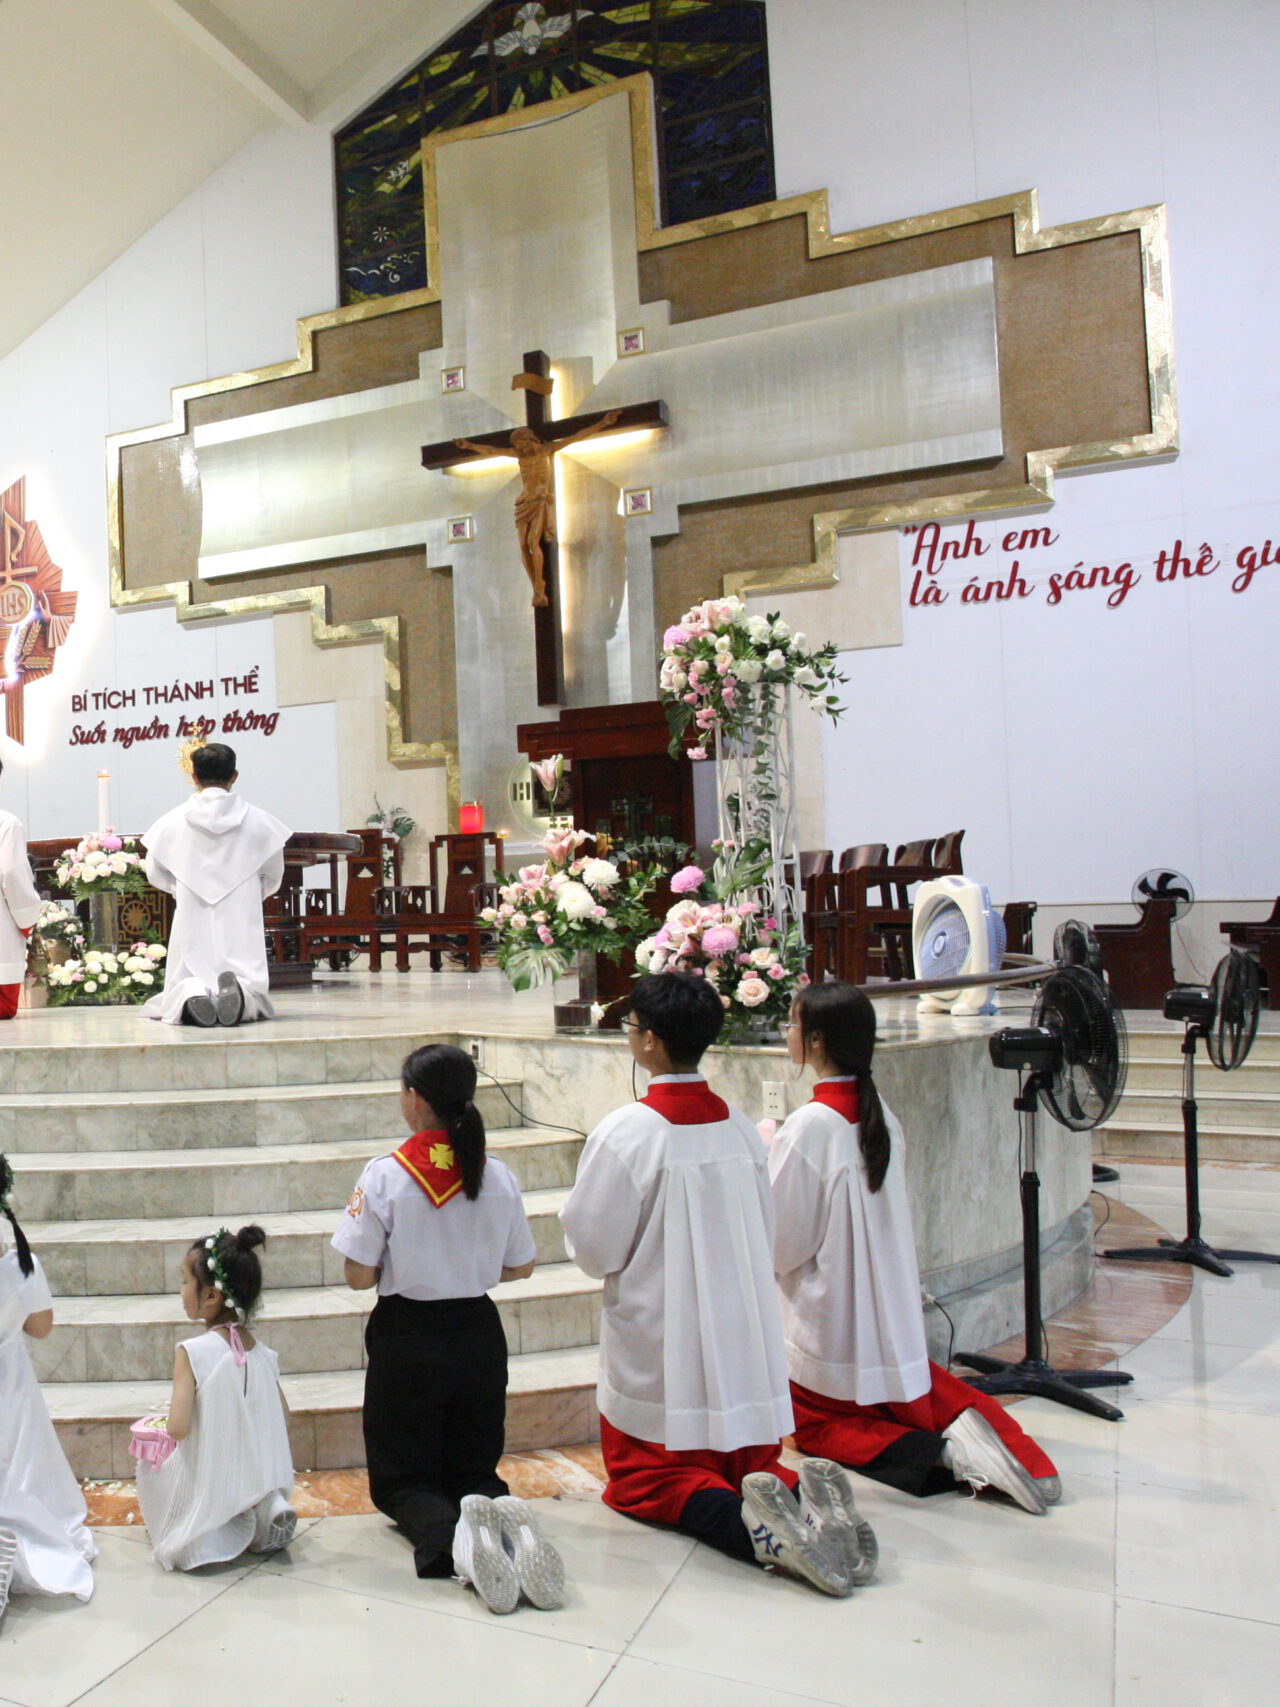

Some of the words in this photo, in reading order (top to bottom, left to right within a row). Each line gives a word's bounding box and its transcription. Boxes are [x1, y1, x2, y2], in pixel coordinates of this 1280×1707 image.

[1002, 526, 1060, 552] em
[909, 570, 949, 606] là
[960, 561, 1034, 604] ánh
[1046, 561, 1141, 607] sáng
[1153, 540, 1221, 582] thế
[72, 689, 88, 713] BÍ
[91, 687, 136, 711] TÍCH
[142, 679, 214, 706] THÁNH
[220, 665, 260, 696] THỂ
[69, 720, 107, 746] Suối
[112, 715, 170, 750] nguồn
[222, 709, 280, 737] thông
